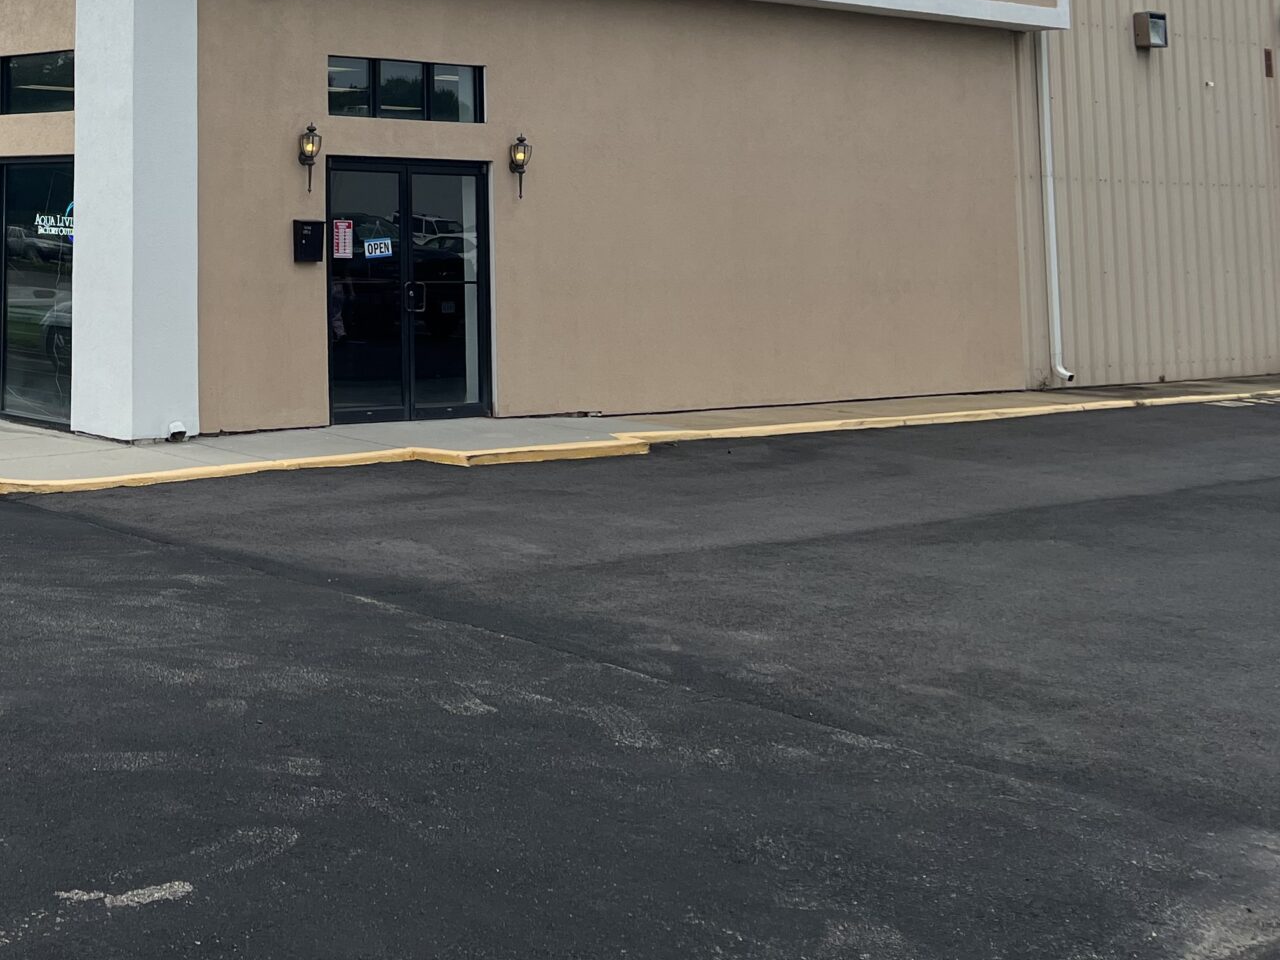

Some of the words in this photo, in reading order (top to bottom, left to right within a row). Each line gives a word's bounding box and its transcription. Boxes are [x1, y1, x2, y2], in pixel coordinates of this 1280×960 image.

[34, 213, 56, 227] AQUA
[56, 214, 74, 227] LIVI
[367, 242, 390, 255] OPEN
